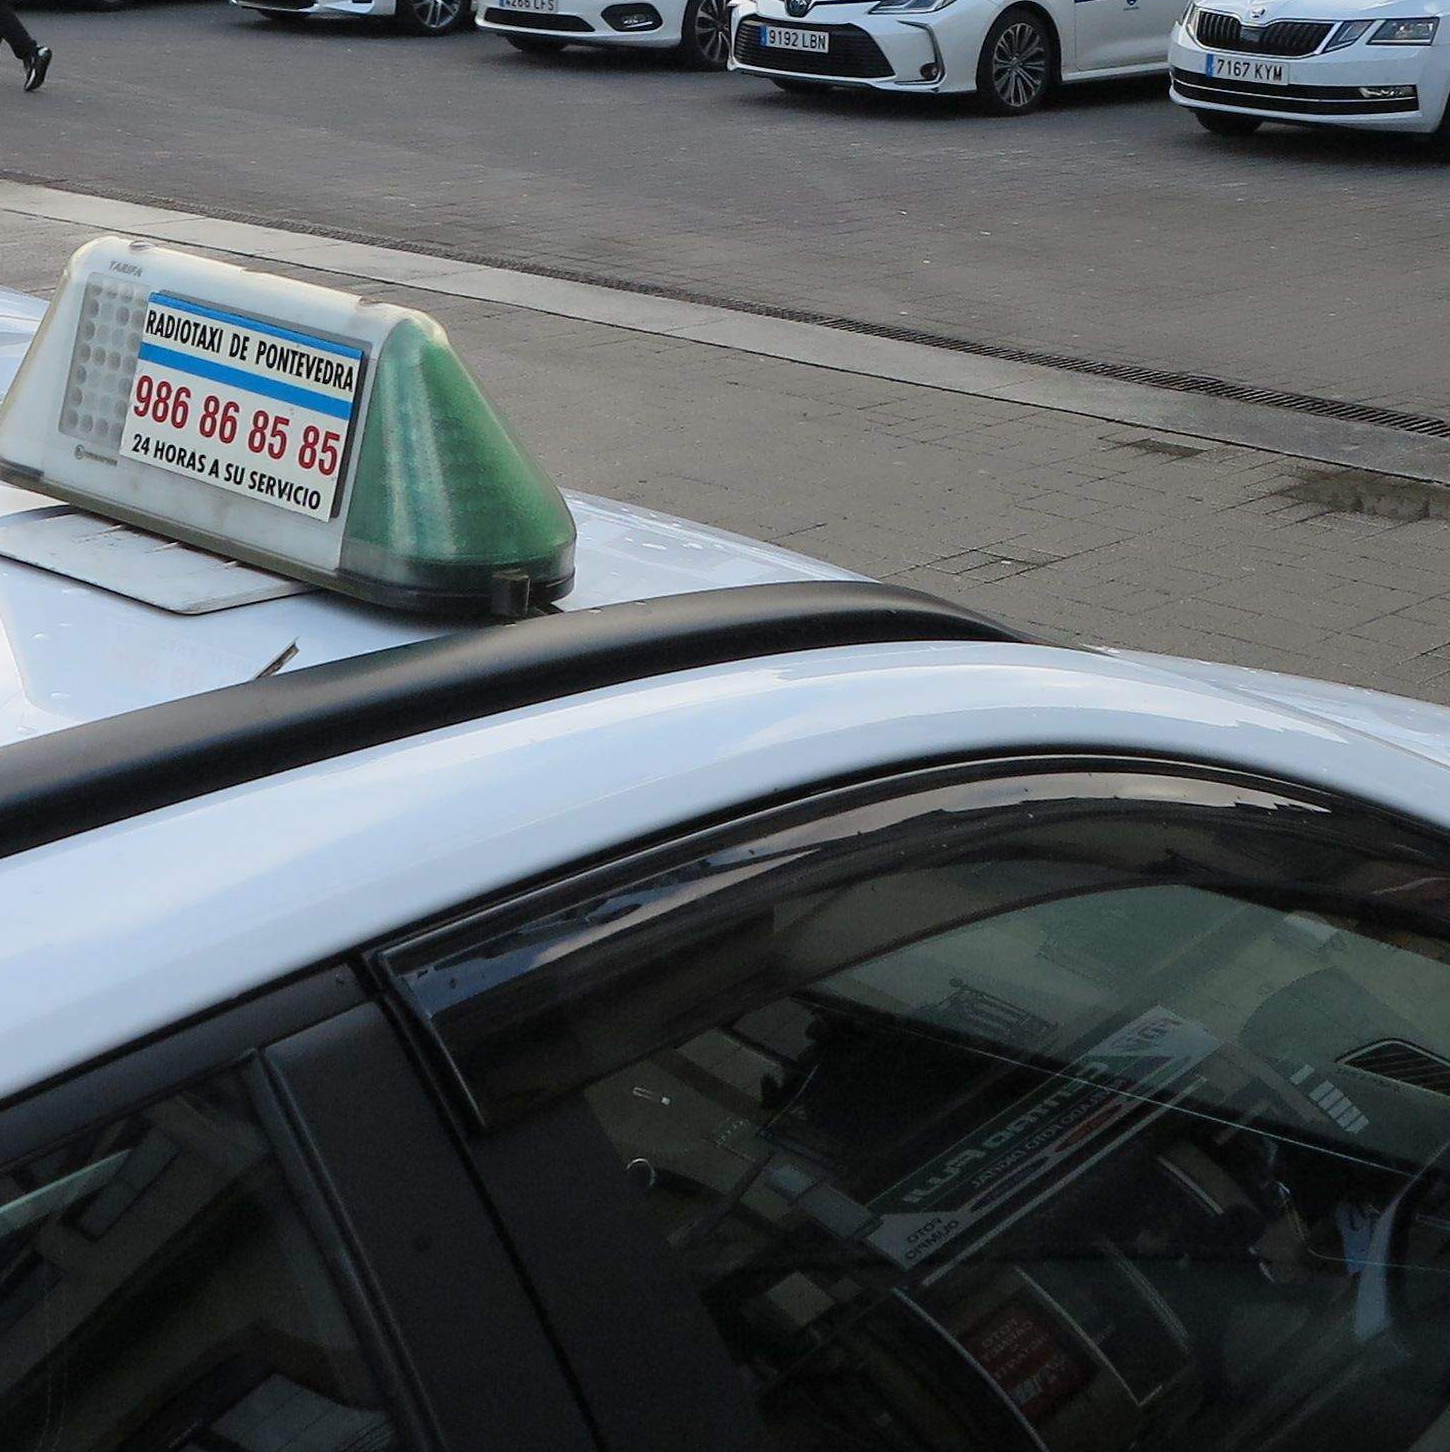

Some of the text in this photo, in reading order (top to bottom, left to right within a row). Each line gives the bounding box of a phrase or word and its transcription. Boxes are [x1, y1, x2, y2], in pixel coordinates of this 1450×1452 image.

[769, 29, 827, 50] 9192 LBN
[1217, 59, 1283, 82] 7167 KYM
[109, 260, 143, 278] TARIFA
[144, 309, 355, 393] RADIOTAXI DE PONTEVEDRA
[133, 374, 342, 476] 986 86 85 85
[131, 433, 322, 511] 24 HORAS A SU SERVICIO
